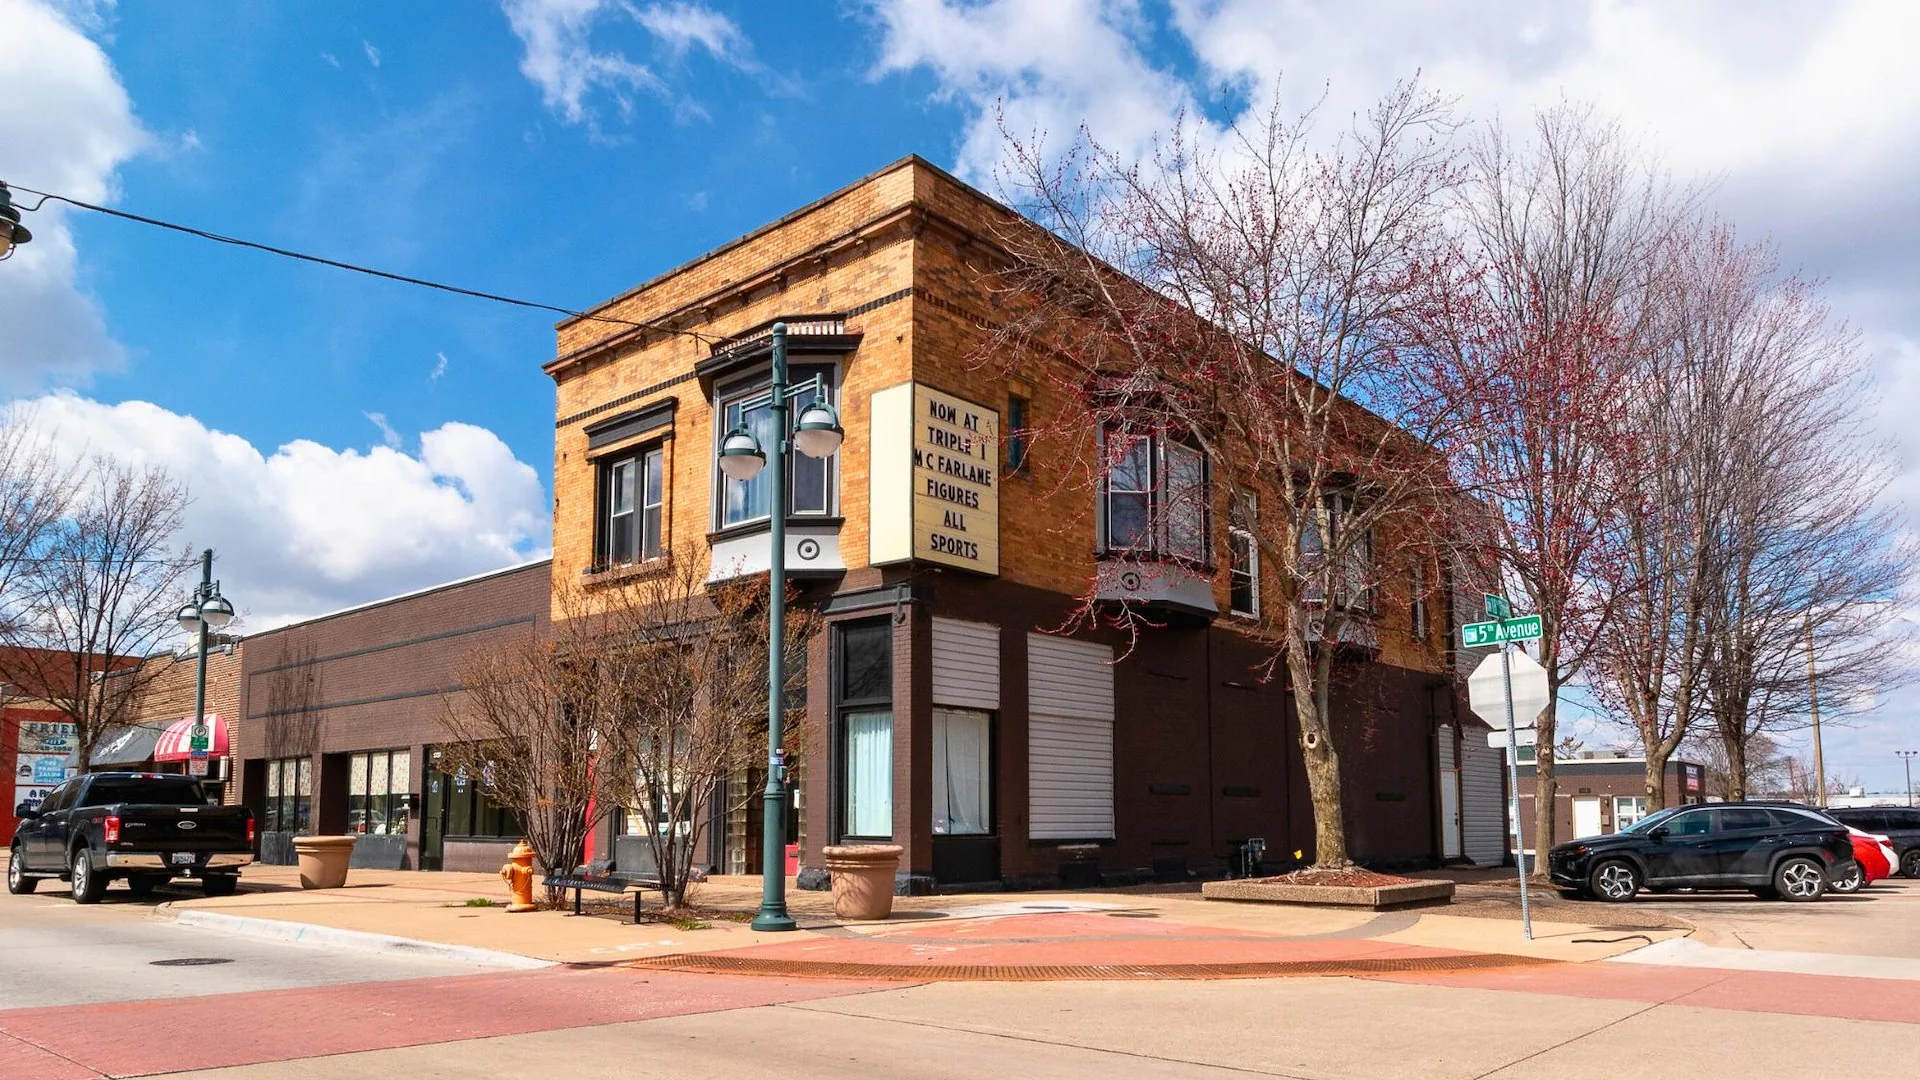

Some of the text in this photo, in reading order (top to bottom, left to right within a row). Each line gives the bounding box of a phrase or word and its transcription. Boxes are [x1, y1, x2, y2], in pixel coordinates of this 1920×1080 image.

[930, 400, 978, 432] NOW AT
[928, 426, 971, 455] TRIPLE
[927, 478, 979, 509] FIGURES
[944, 510, 966, 532] ALL
[931, 534, 978, 560] SPORTS
[1479, 625, 1493, 642] 5th
[1496, 622, 1538, 640] Avenue
